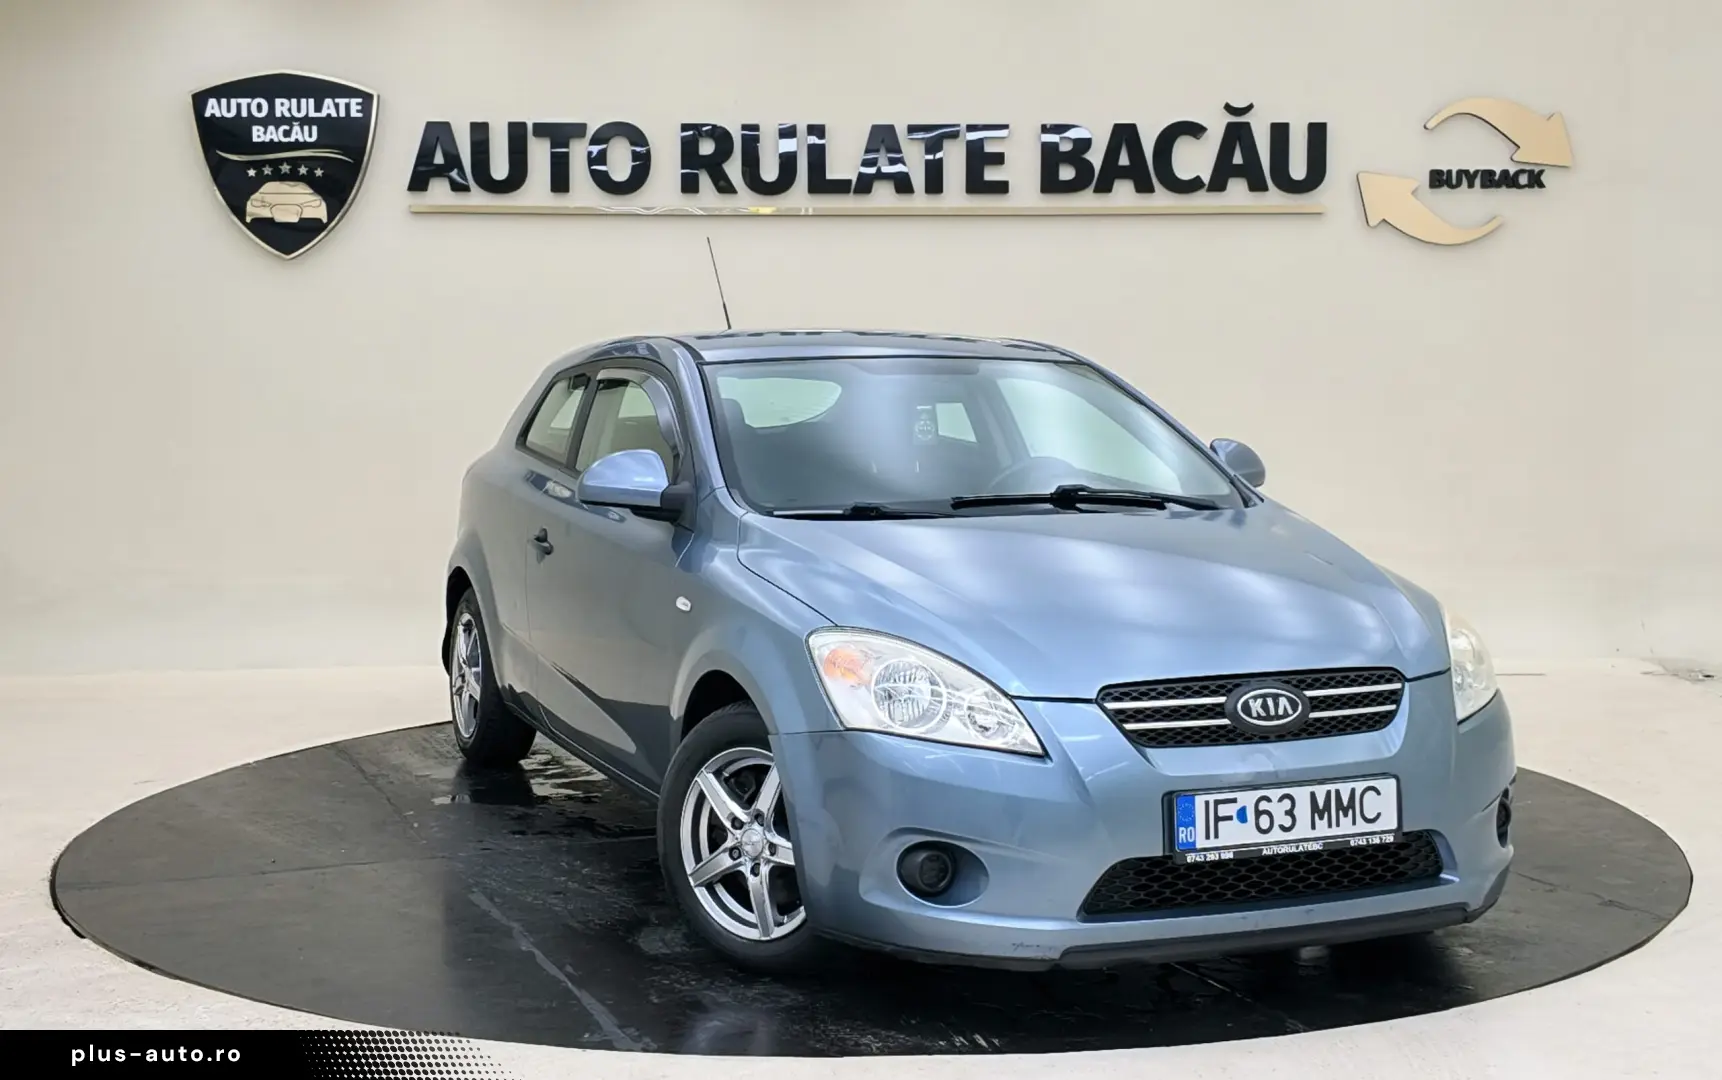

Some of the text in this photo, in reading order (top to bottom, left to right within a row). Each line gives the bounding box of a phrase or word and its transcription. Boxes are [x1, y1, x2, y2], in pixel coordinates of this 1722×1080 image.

[204, 97, 363, 118] AUTO RULATE
[252, 121, 318, 142] BACĂU
[407, 101, 1328, 196] AUTO RULATE BACĂU
[1428, 168, 1546, 189] BUYBACK
[1248, 696, 1293, 718] KIA
[1178, 785, 1382, 844] RO IF 63 MMC
[1261, 842, 1324, 856] AUTORULATEBC
